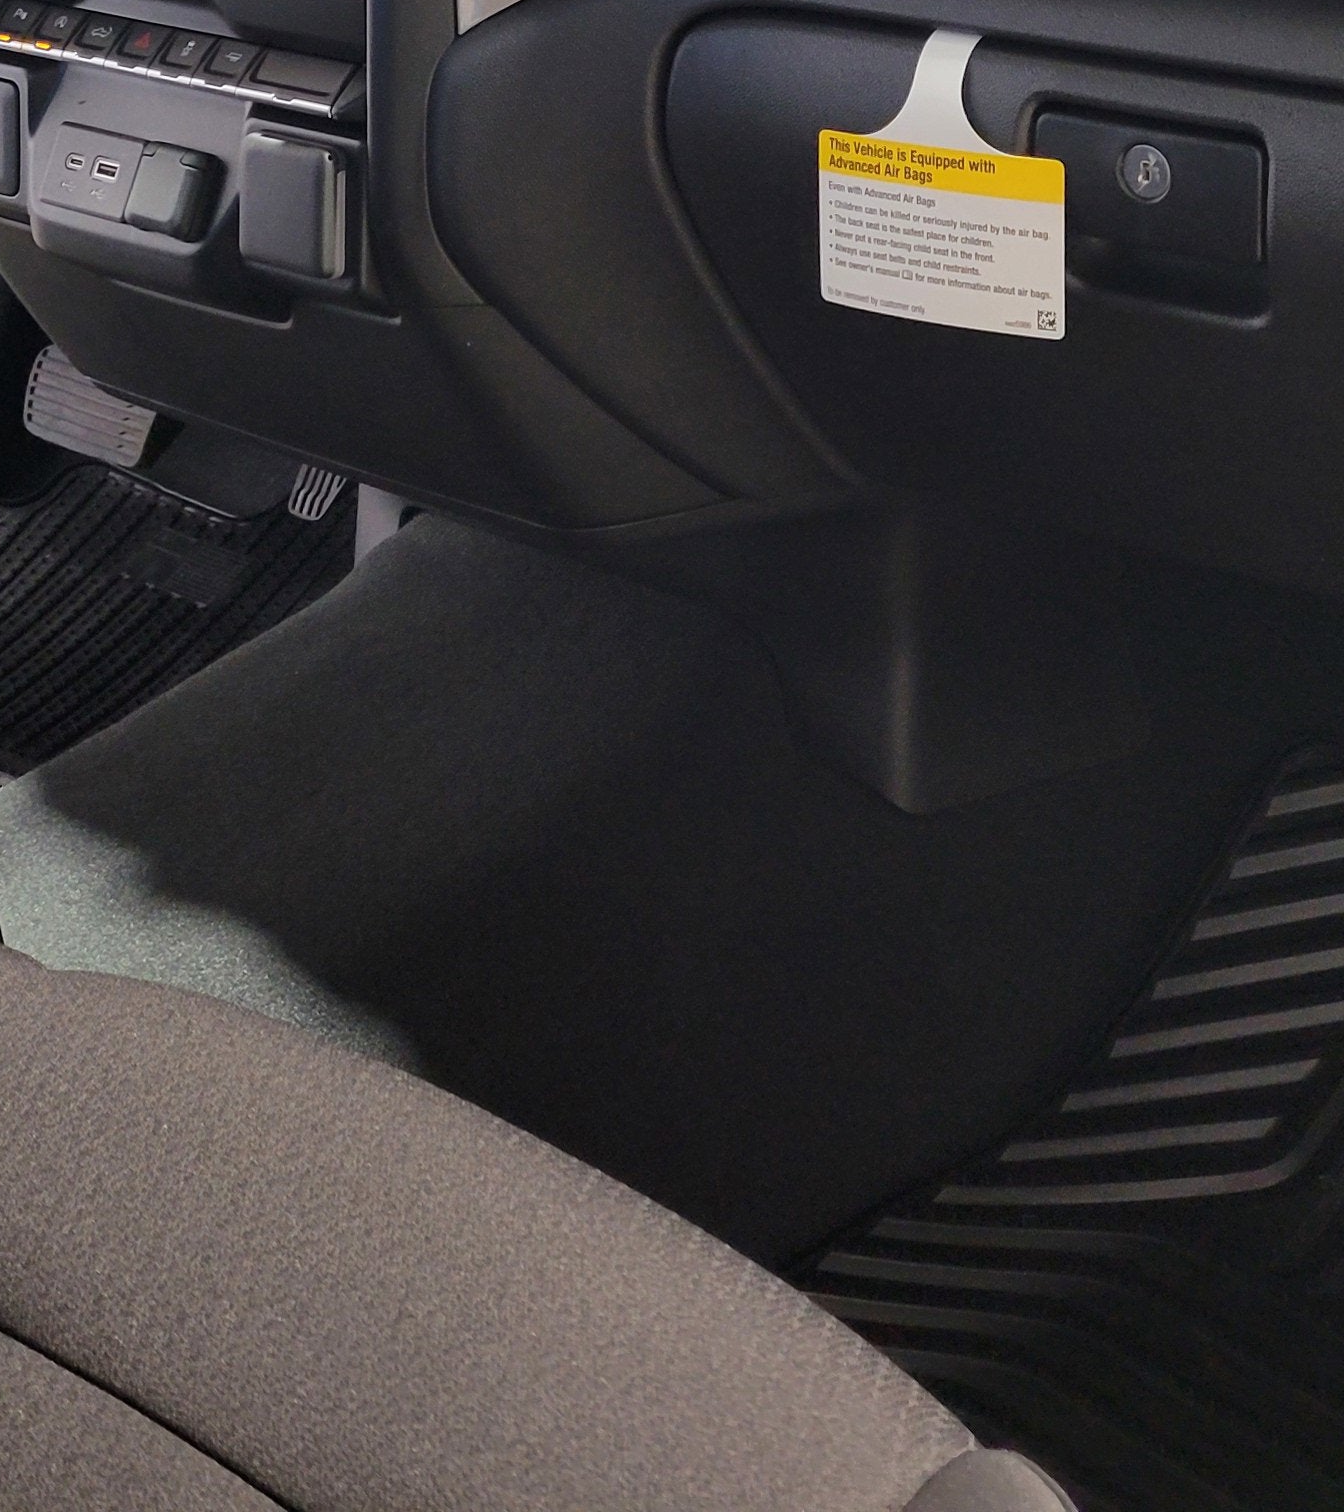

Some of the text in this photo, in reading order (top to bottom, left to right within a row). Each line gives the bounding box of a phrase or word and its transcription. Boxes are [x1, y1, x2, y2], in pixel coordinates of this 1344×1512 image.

[829, 154, 933, 185] Advanced Air Bags
[830, 138, 995, 174] This Vehicle is Equipped with
[828, 180, 936, 208] Even with Advanced Air Bags
[834, 199, 863, 212] Children
[865, 207, 878, 215] can
[880, 208, 888, 217] be
[891, 210, 911, 221] killed
[923, 216, 957, 230] seriously
[959, 221, 988, 232] injured
[990, 224, 1000, 235] by
[1002, 226, 1016, 236] the
[1018, 229, 1030, 237] air
